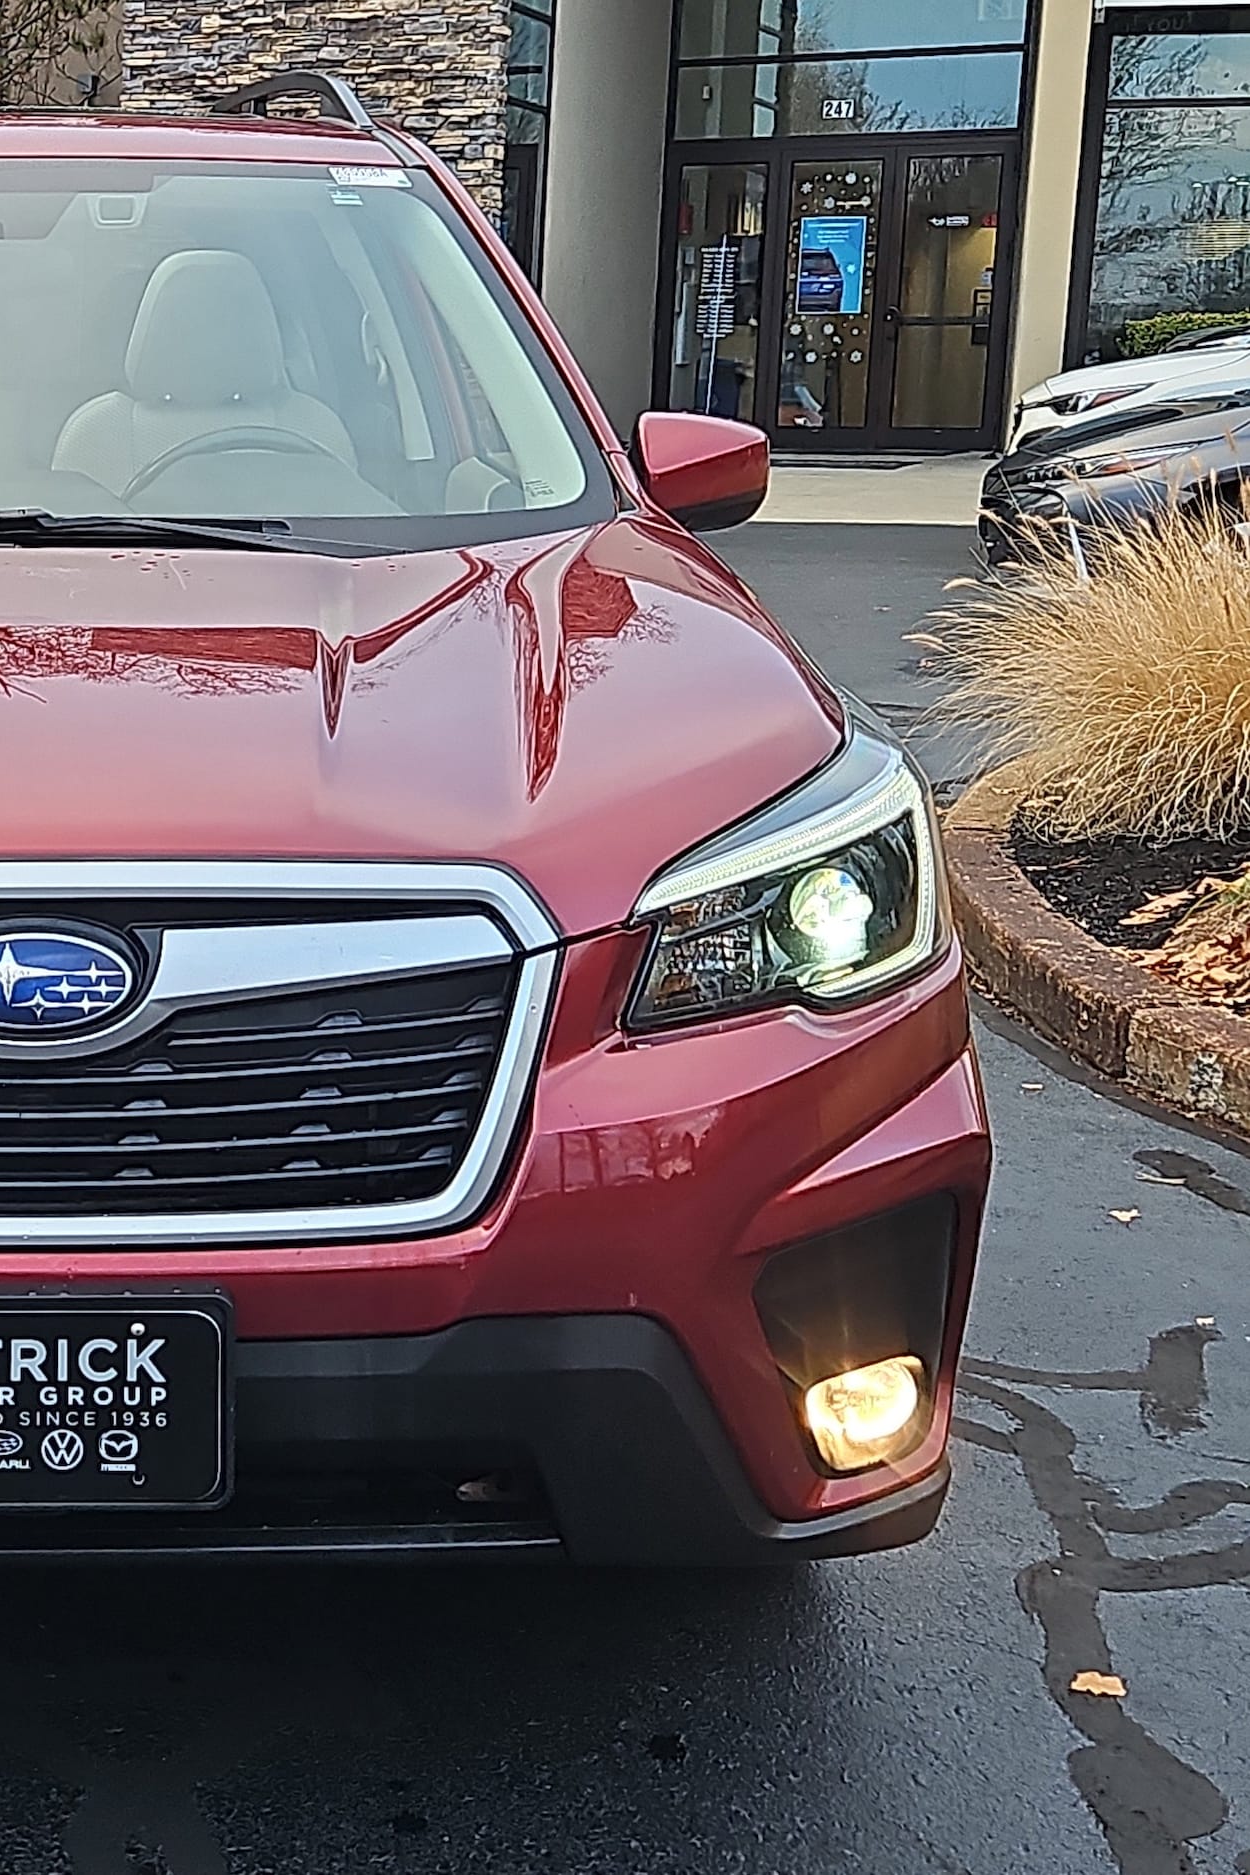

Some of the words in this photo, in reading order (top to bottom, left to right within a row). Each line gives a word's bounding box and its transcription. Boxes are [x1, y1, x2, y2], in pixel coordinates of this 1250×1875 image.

[825, 101, 852, 117] 247
[39, 1386, 168, 1407] GROUP
[19, 1411, 97, 1427] SINCE
[111, 1411, 168, 1428] 1936
